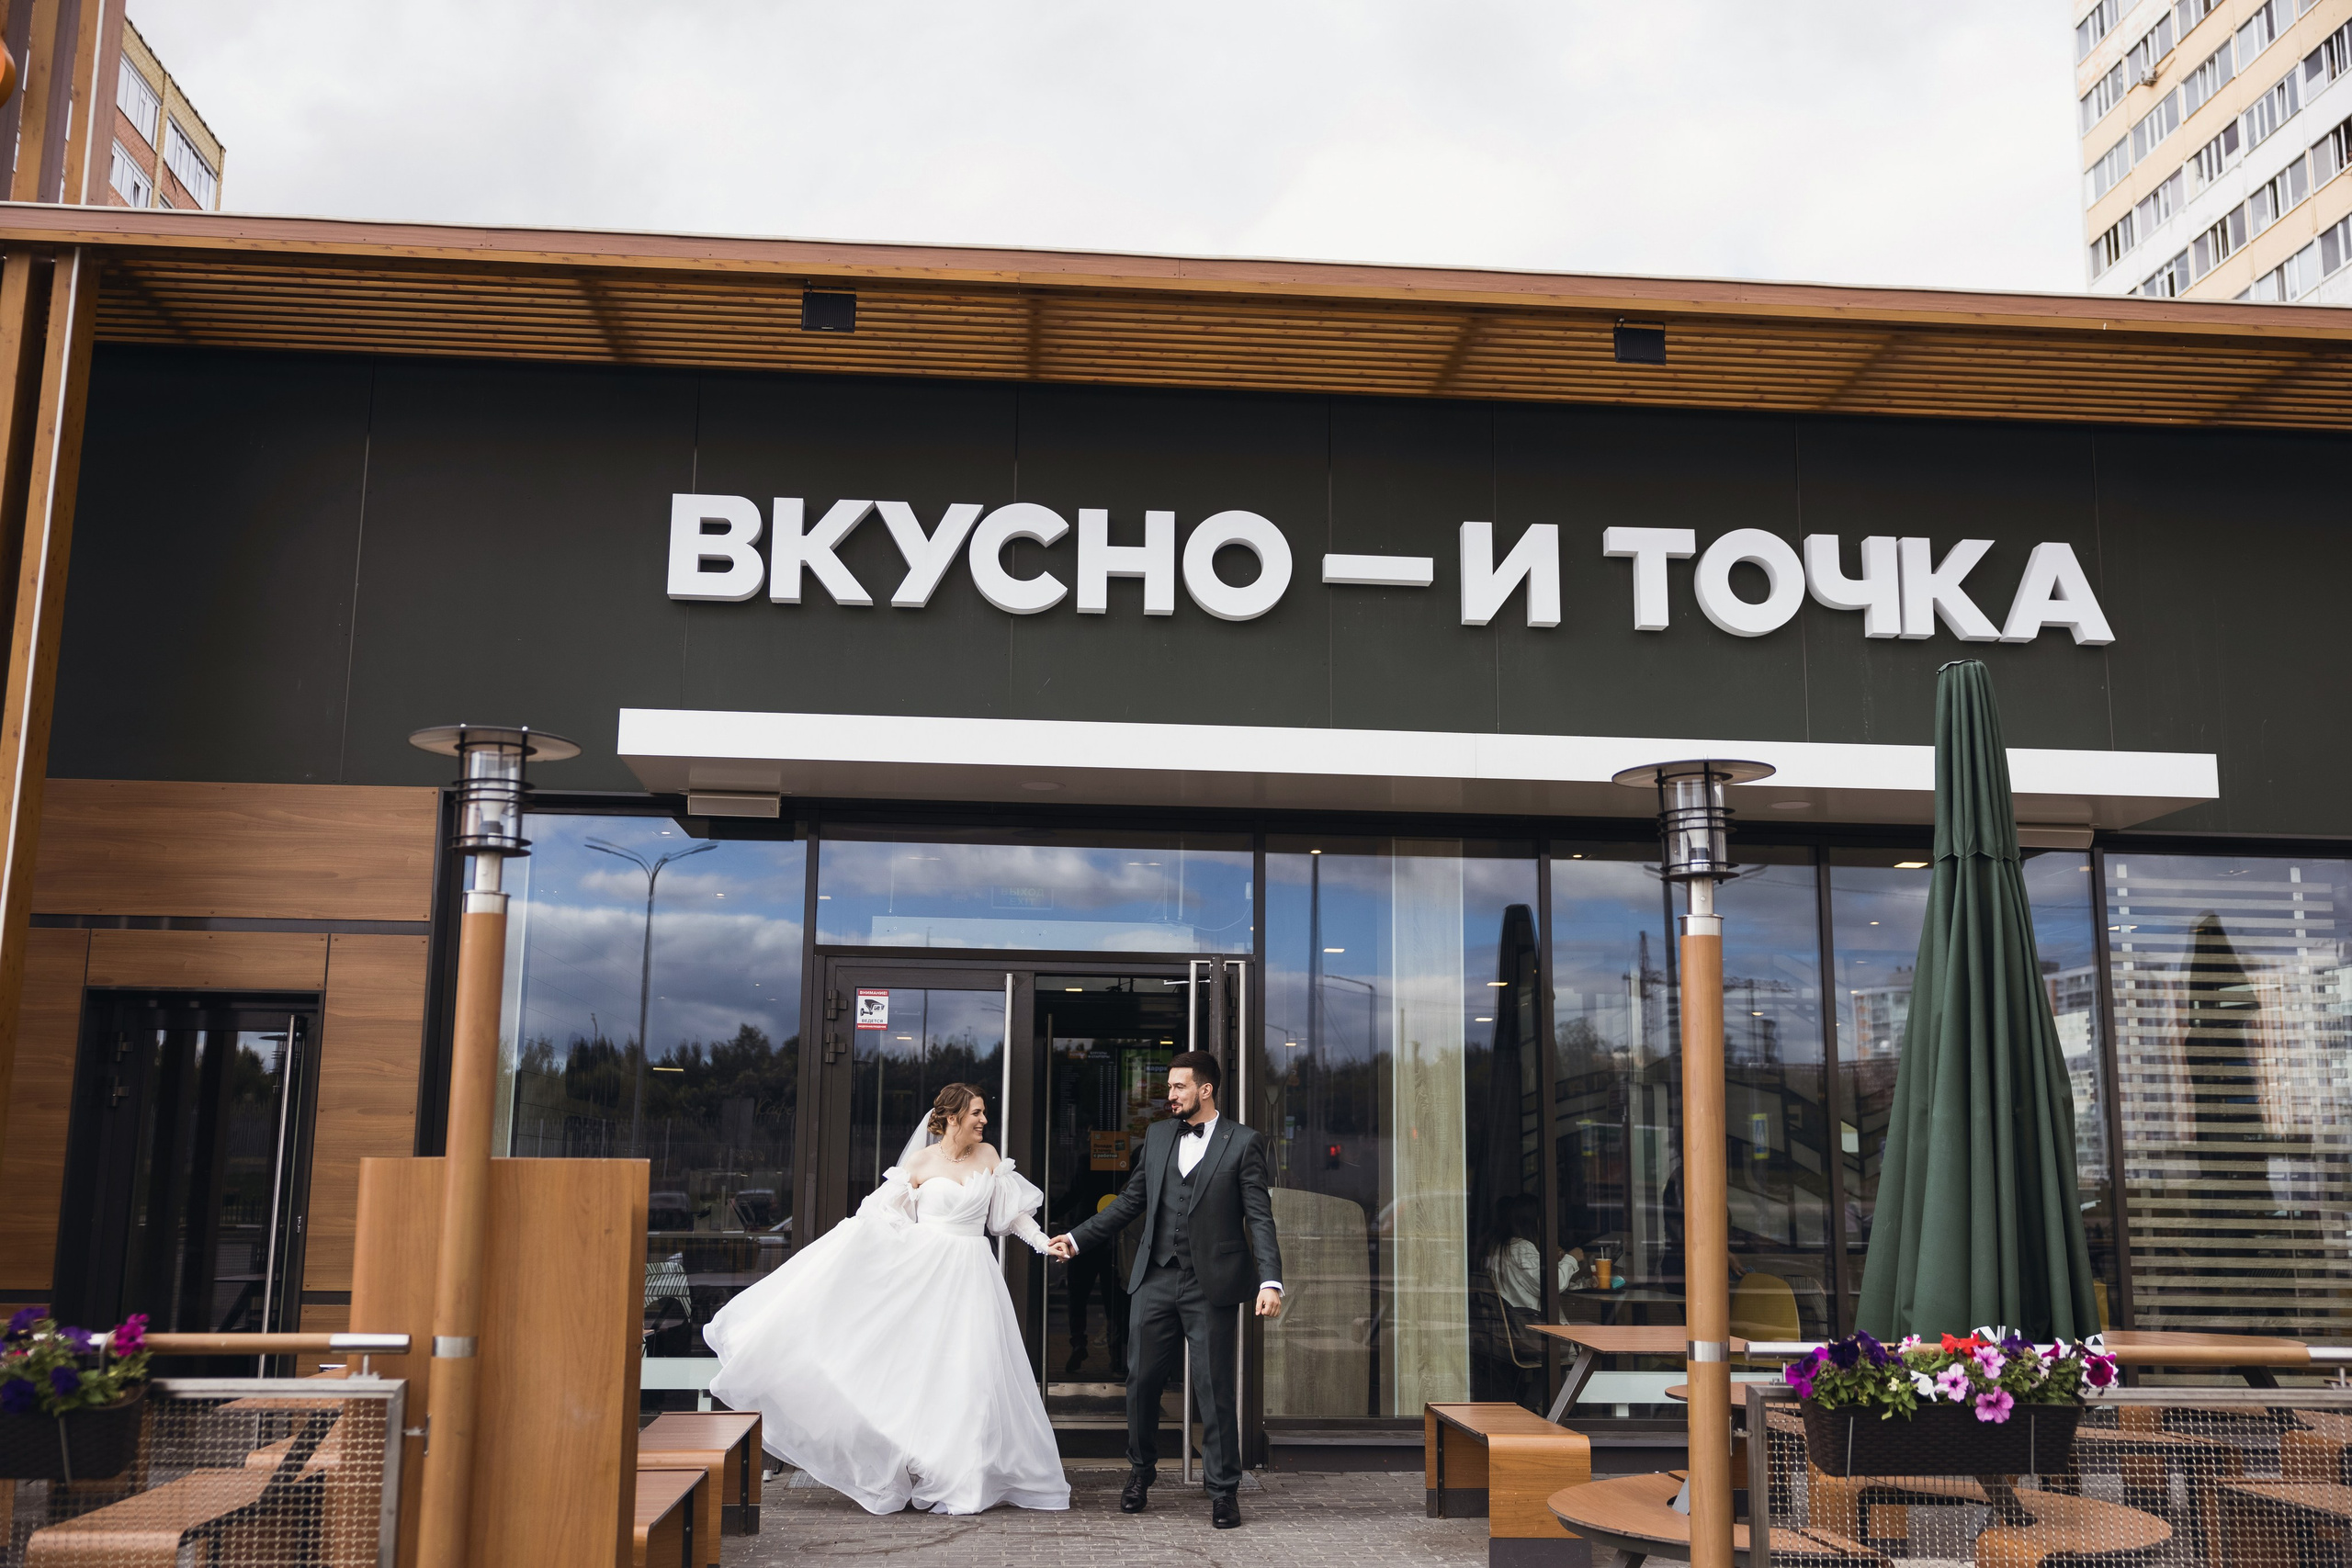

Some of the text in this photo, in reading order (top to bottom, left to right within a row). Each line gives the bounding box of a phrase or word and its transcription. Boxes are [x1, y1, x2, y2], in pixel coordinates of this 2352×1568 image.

[667, 493, 1293, 622] ВКУСНО
[1460, 521, 1561, 628] И
[1603, 526, 2116, 646] ТОЧКА
[1001, 887, 1045, 898] ВЫХОД
[1009, 897, 1035, 906] EXIT
[756, 1098, 796, 1122] Кафе
